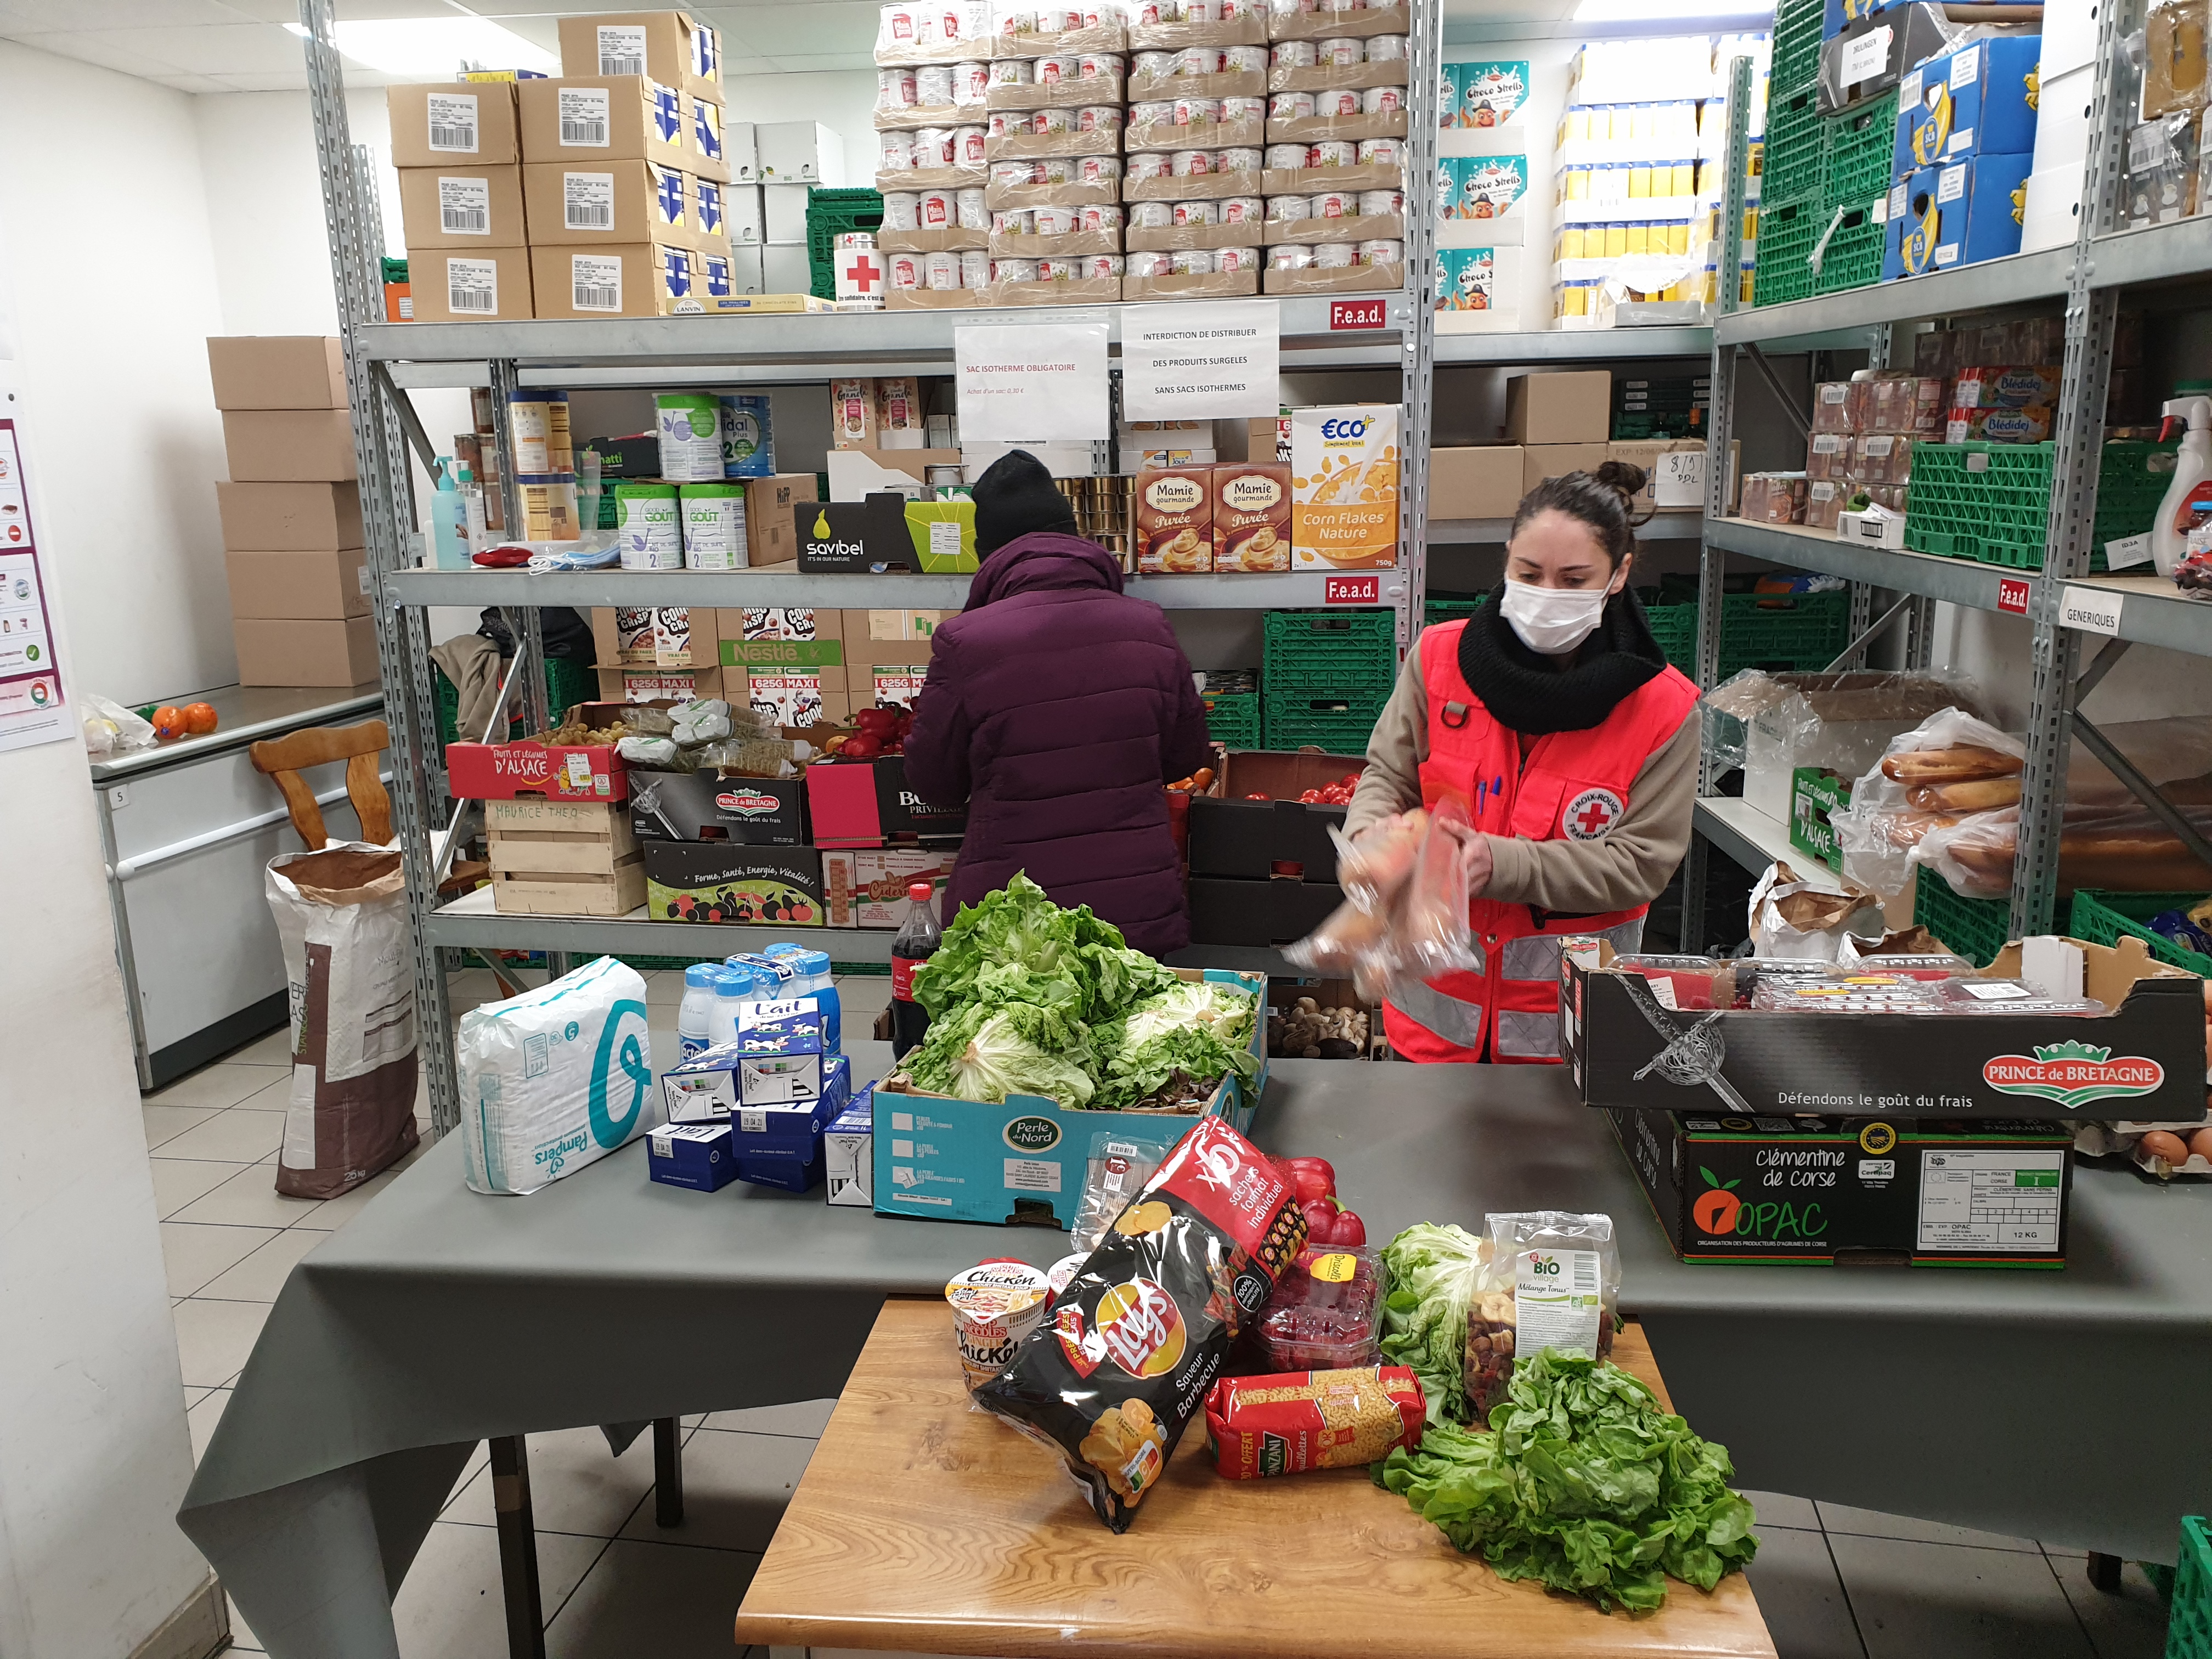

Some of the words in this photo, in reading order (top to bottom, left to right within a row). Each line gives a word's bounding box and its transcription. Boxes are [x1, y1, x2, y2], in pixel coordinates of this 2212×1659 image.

[1334, 305, 1381, 324] F.e.a.d.
[1143, 331, 1197, 340] INTERDICTION
[1211, 329, 1256, 337] DISTRIBUER
[1026, 364, 1076, 372] OBLIGATOIRE
[1169, 358, 1207, 366] PRODUITS
[1209, 357, 1248, 365] SURGELES
[1197, 383, 1246, 392] ISOTHERMES
[1157, 484, 1194, 496] Mamie
[1234, 483, 1272, 494] Mamie
[1156, 496, 1194, 505] gourmande
[1233, 494, 1272, 504] gourmande
[1155, 512, 1191, 529] Purée
[1232, 510, 1269, 527] Purée
[1302, 514, 1335, 526] Corn
[1339, 512, 1384, 524] Flakes
[1319, 528, 1368, 539] Nature
[806, 539, 864, 555] savibel
[650, 554, 657, 568] 2
[693, 554, 700, 568] 2
[1329, 581, 1375, 598] F.e.a.d.
[2000, 584, 2025, 607] F.e.a.d.
[2067, 609, 2115, 628] GENERIQUES
[631, 679, 659, 688] 625G
[662, 679, 689, 688] MAXI
[755, 679, 783, 687] 625G
[787, 679, 814, 687] MAXI
[881, 679, 909, 687] 625G
[494, 749, 511, 759] FRUITS
[513, 750, 521, 758] ET
[495, 759, 548, 777] D'ALSACE
[746, 798, 777, 807] BRETAGNE
[1571, 793, 1619, 815] CROIX-ROUGE
[496, 805, 542, 819] MAURICE
[695, 874, 721, 883] Forme,
[722, 867, 745, 878] Santé,
[747, 865, 777, 878] Energie,
[755, 1001, 802, 1015] Lait
[1989, 1064, 2046, 1082] PRINCE
[2048, 1066, 2064, 1081] de
[2067, 1065, 2154, 1082] BRETAGNE
[1778, 1091, 1853, 1106] Défendons
[1860, 1092, 1873, 1106] le
[1878, 1092, 1910, 1109] goût
[1916, 1093, 1934, 1108] du
[1939, 1094, 1973, 1108] frais
[1017, 1122, 1049, 1134] Perle
[1021, 1132, 1052, 1143] Nord
[535, 1131, 588, 1165] Pampers
[1756, 1148, 1846, 1167] Clémentine
[344, 1171, 358, 1182] 25
[1763, 1169, 1784, 1187] de
[1790, 1169, 1837, 1187] Corse
[1861, 1169, 1892, 1177] Certipaq
[1229, 1166, 1260, 1206] sachets
[1241, 1177, 1269, 1213] format
[1247, 1180, 1283, 1229] individuel
[1735, 1201, 1829, 1240] OPAC
[1533, 1274, 1560, 1284] village
[1517, 1283, 1547, 1294] Mélange
[1548, 1285, 1566, 1293] Tonus
[963, 1323, 1007, 1338] NOODLES
[967, 1338, 1005, 1347] GINGER
[1176, 1352, 1204, 1392] Saveur
[1177, 1353, 1221, 1419] Barbecue
[1241, 1431, 1253, 1464] OFFERT
[1296, 1430, 1307, 1471] quillettes
